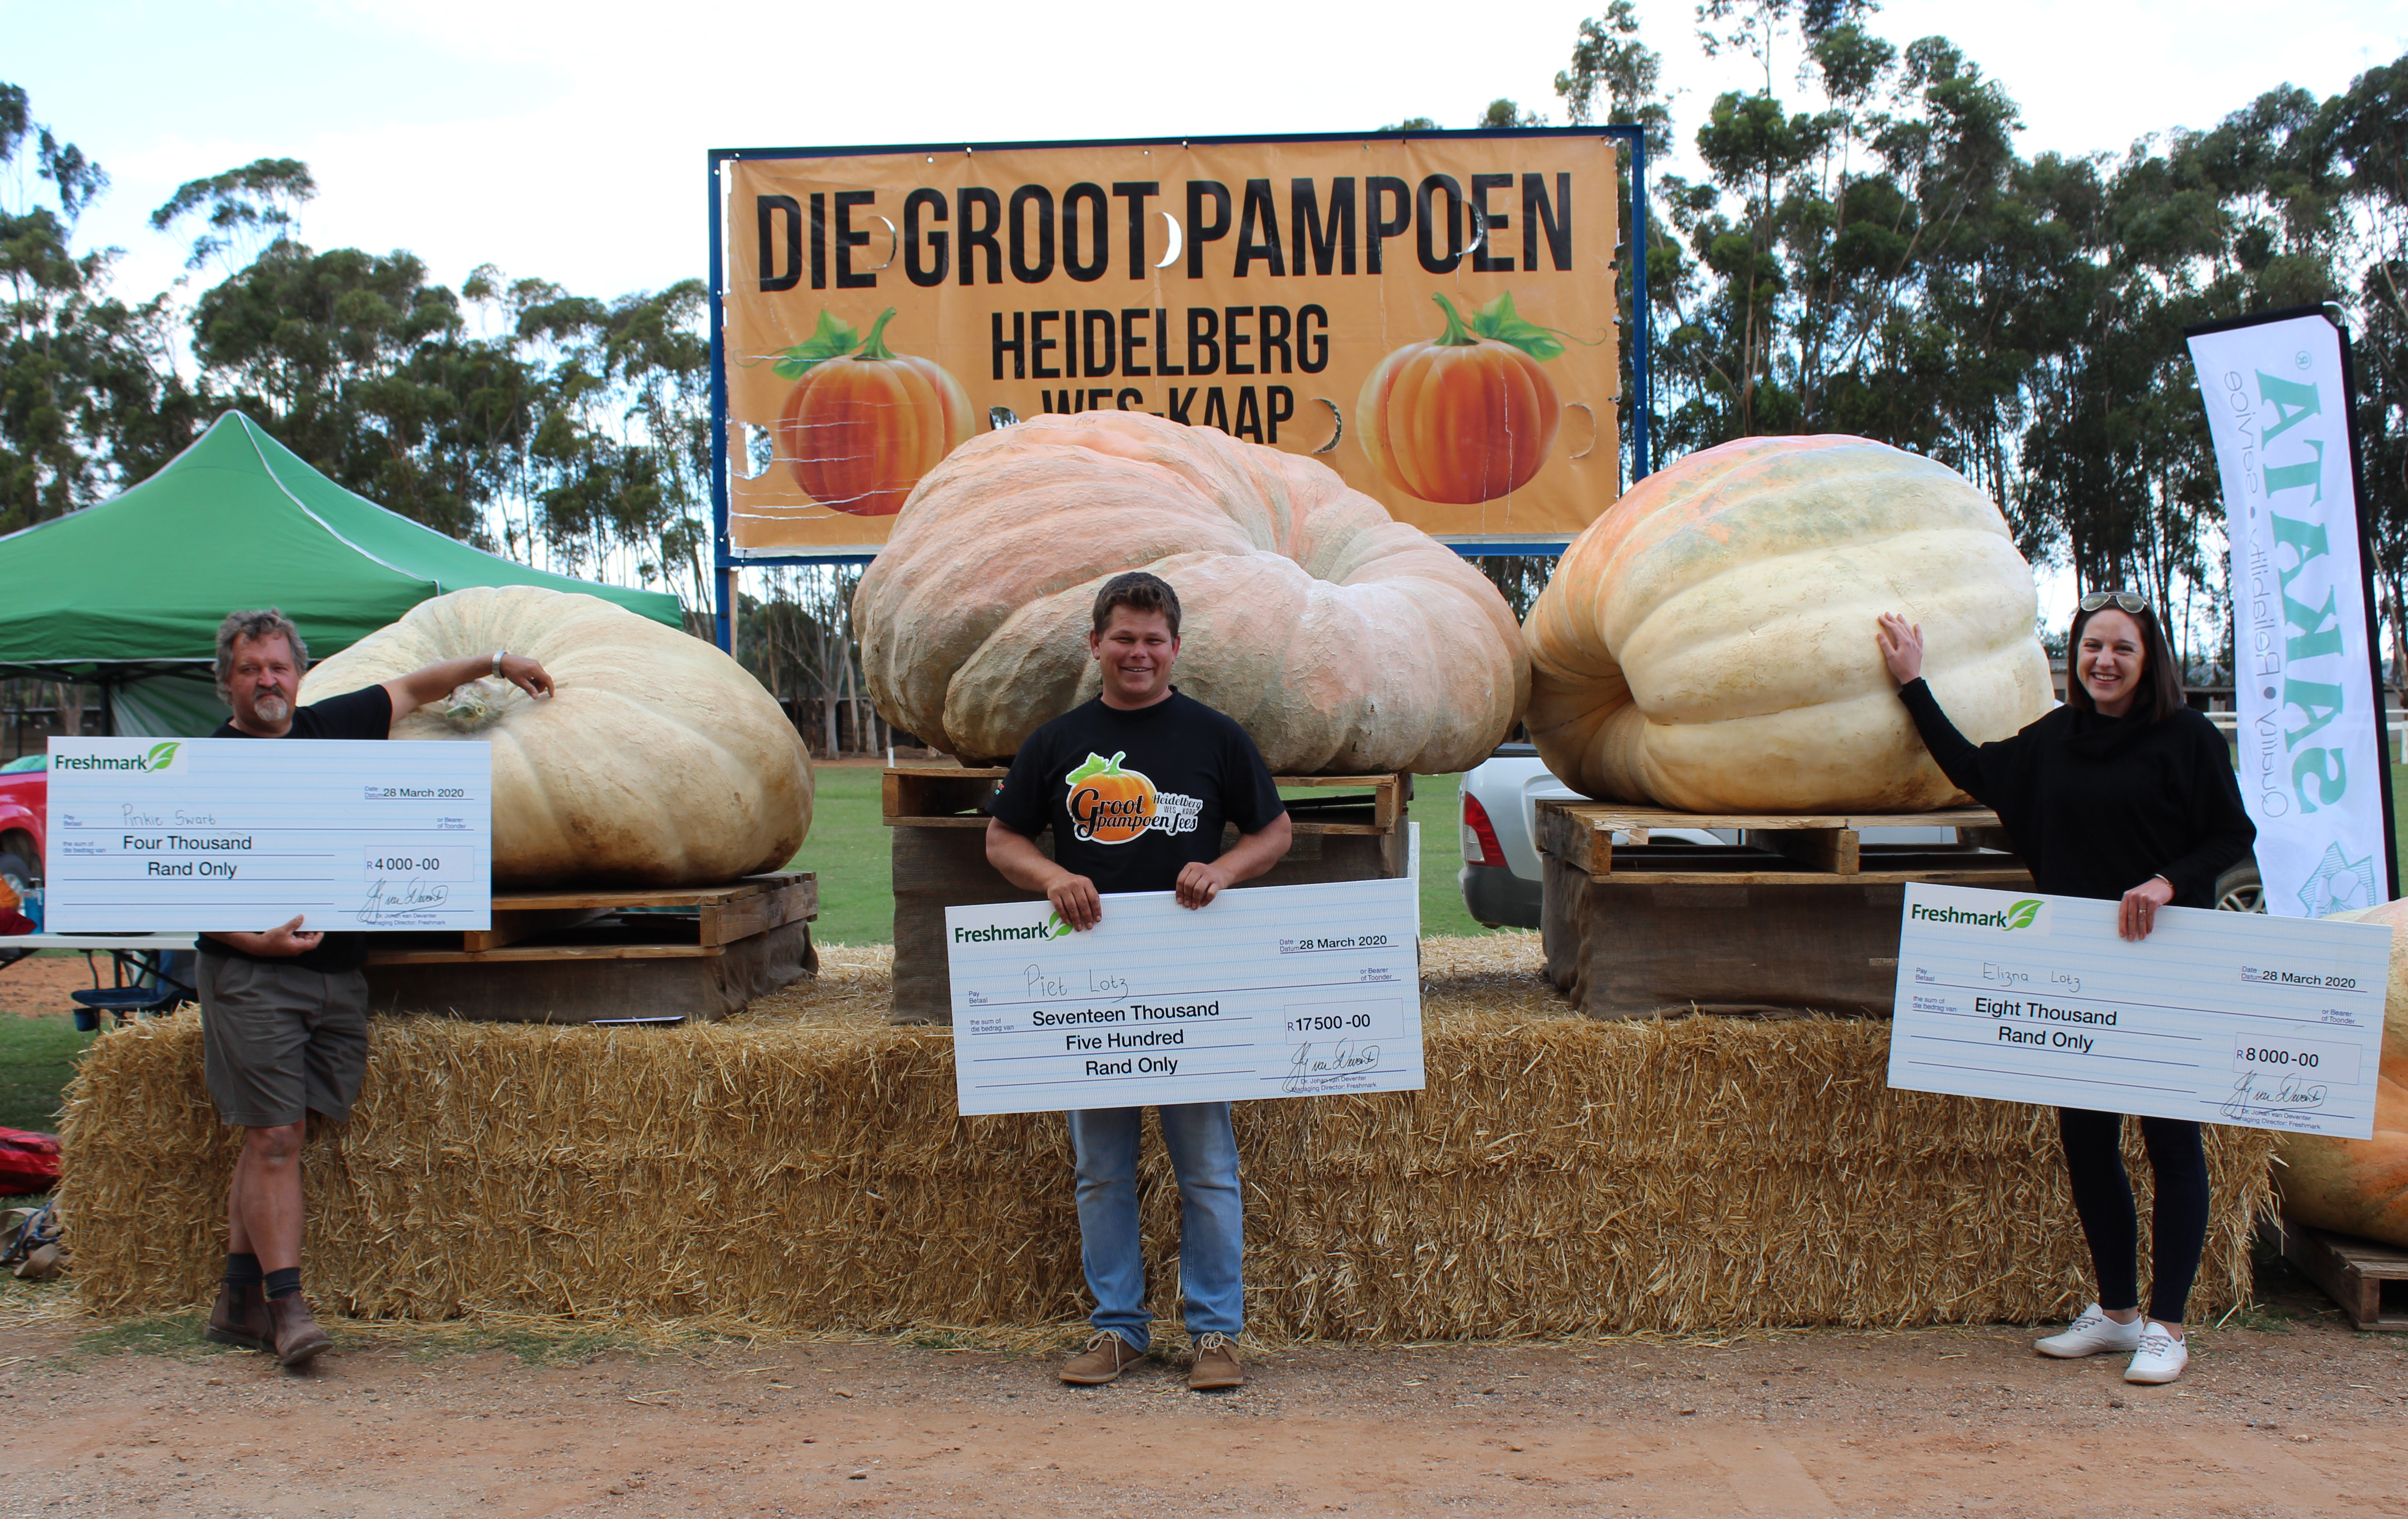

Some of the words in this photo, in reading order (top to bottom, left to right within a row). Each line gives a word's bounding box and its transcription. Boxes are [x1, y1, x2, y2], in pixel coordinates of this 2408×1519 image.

[757, 190, 877, 292] DIE
[904, 182, 1160, 287] GROOT
[1186, 172, 1572, 279] PAMPOEN
[992, 304, 1329, 380] HEIDELBERG
[55, 754, 148, 770] Freshmark
[383, 788, 397, 797] 28
[400, 789, 434, 797] March
[438, 789, 464, 797] 2020
[1152, 794, 1202, 810] Heidelberg
[1071, 788, 1145, 838] Groot
[1164, 805, 1176, 814] WES
[123, 835, 163, 850] Four
[167, 835, 252, 850] Thousand
[148, 861, 193, 876] Rand
[199, 861, 238, 879] Only
[1911, 904, 2007, 928] Freshmark
[955, 922, 1049, 943] Freshmark
[1299, 940, 1314, 949] 28
[1318, 937, 1355, 948] March
[1359, 935, 1387, 946] 2020
[1023, 964, 1068, 997] Piet
[2262, 971, 2278, 981] 28
[2281, 972, 2321, 985] March
[2325, 976, 2356, 988] 2020
[1033, 1008, 1126, 1026] Seventeen
[1130, 1000, 1219, 1020] Thousand
[1923, 1003, 1944, 1012] bedrag
[1975, 997, 2021, 1018] Eight
[2026, 1002, 2117, 1026] Thousand
[2330, 1016, 2356, 1025] Toonder
[1066, 1035, 1102, 1051] Five
[1107, 1029, 1184, 1048] Hundred
[1998, 1026, 2046, 1045] Rand
[2052, 1031, 2094, 1053] Only
[1086, 1058, 1132, 1076] Rand
[1138, 1056, 1178, 1075] Only
[2289, 1121, 2320, 1130] Freshmark
